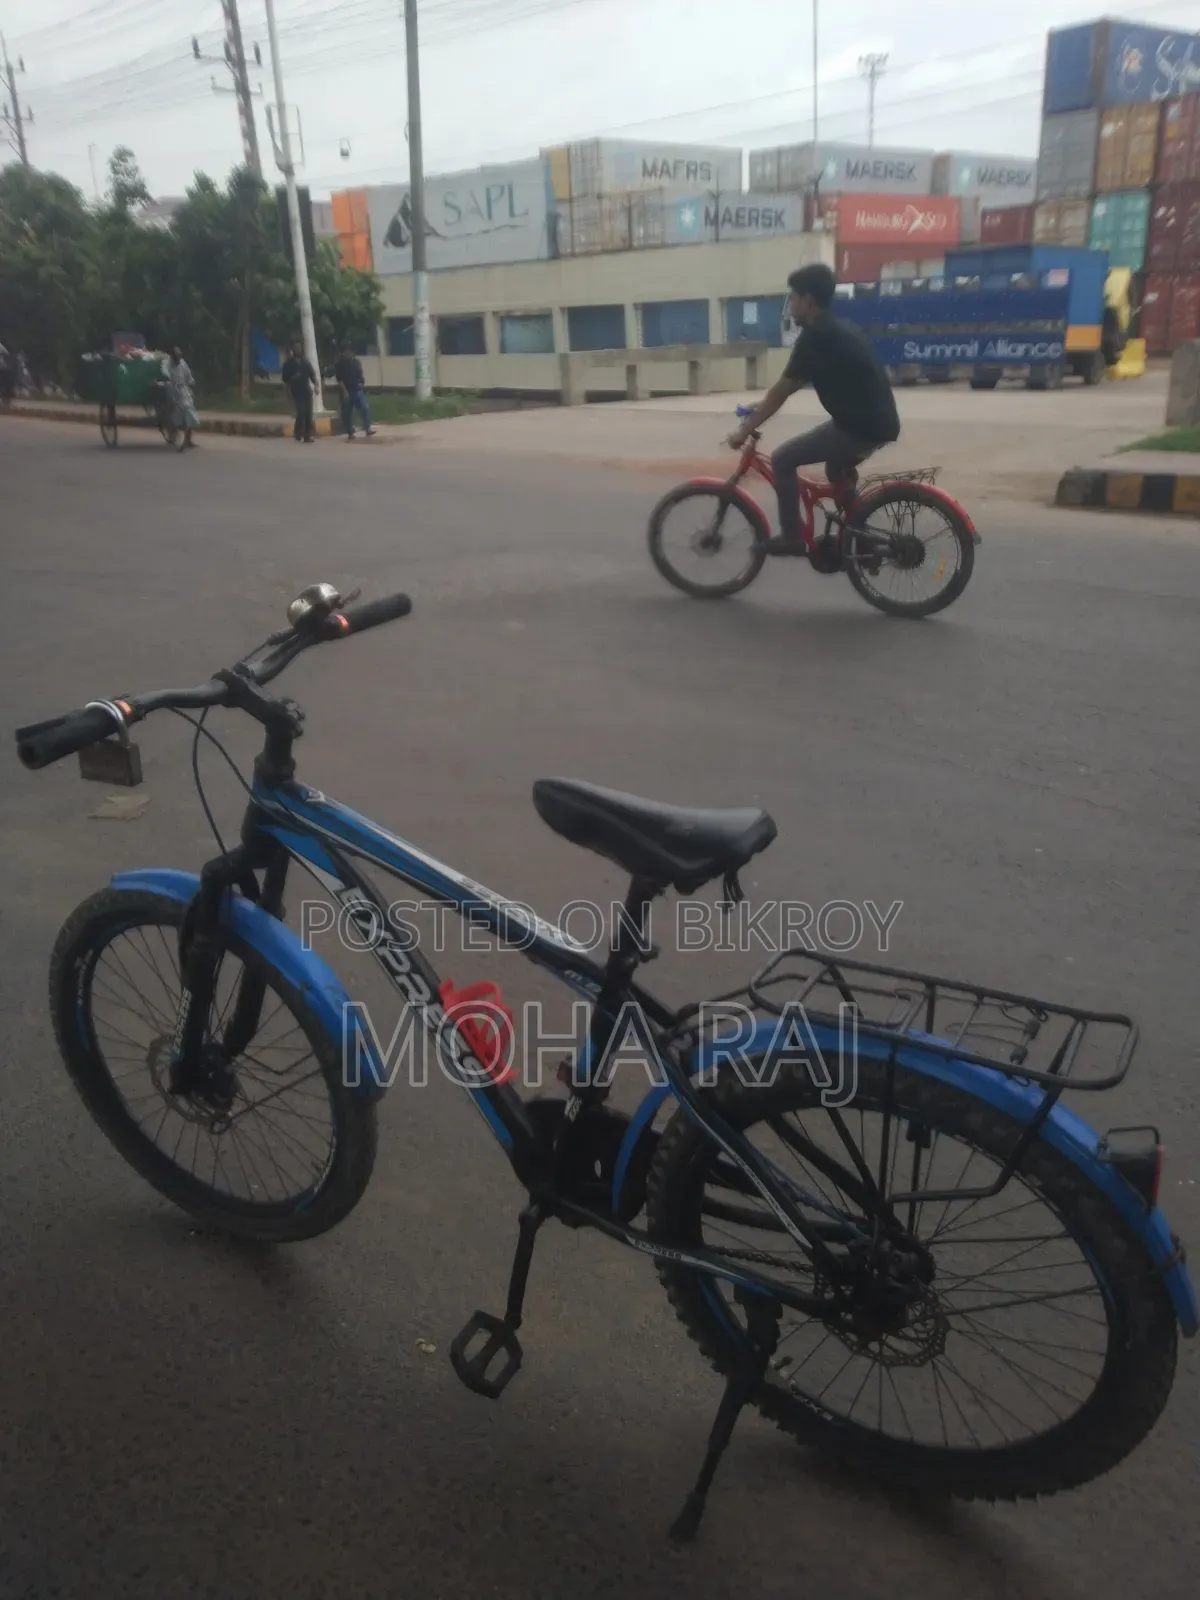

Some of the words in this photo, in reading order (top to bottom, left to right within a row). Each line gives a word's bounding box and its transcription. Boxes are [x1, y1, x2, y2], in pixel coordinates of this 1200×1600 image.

[845, 158, 917, 182] MAERSK
[443, 184, 529, 226] SAPL
[704, 206, 785, 230] MAERSK
[903, 340, 979, 360] Summit
[982, 338, 1063, 360] Alliance
[338, 887, 487, 1087] EXPRESS
